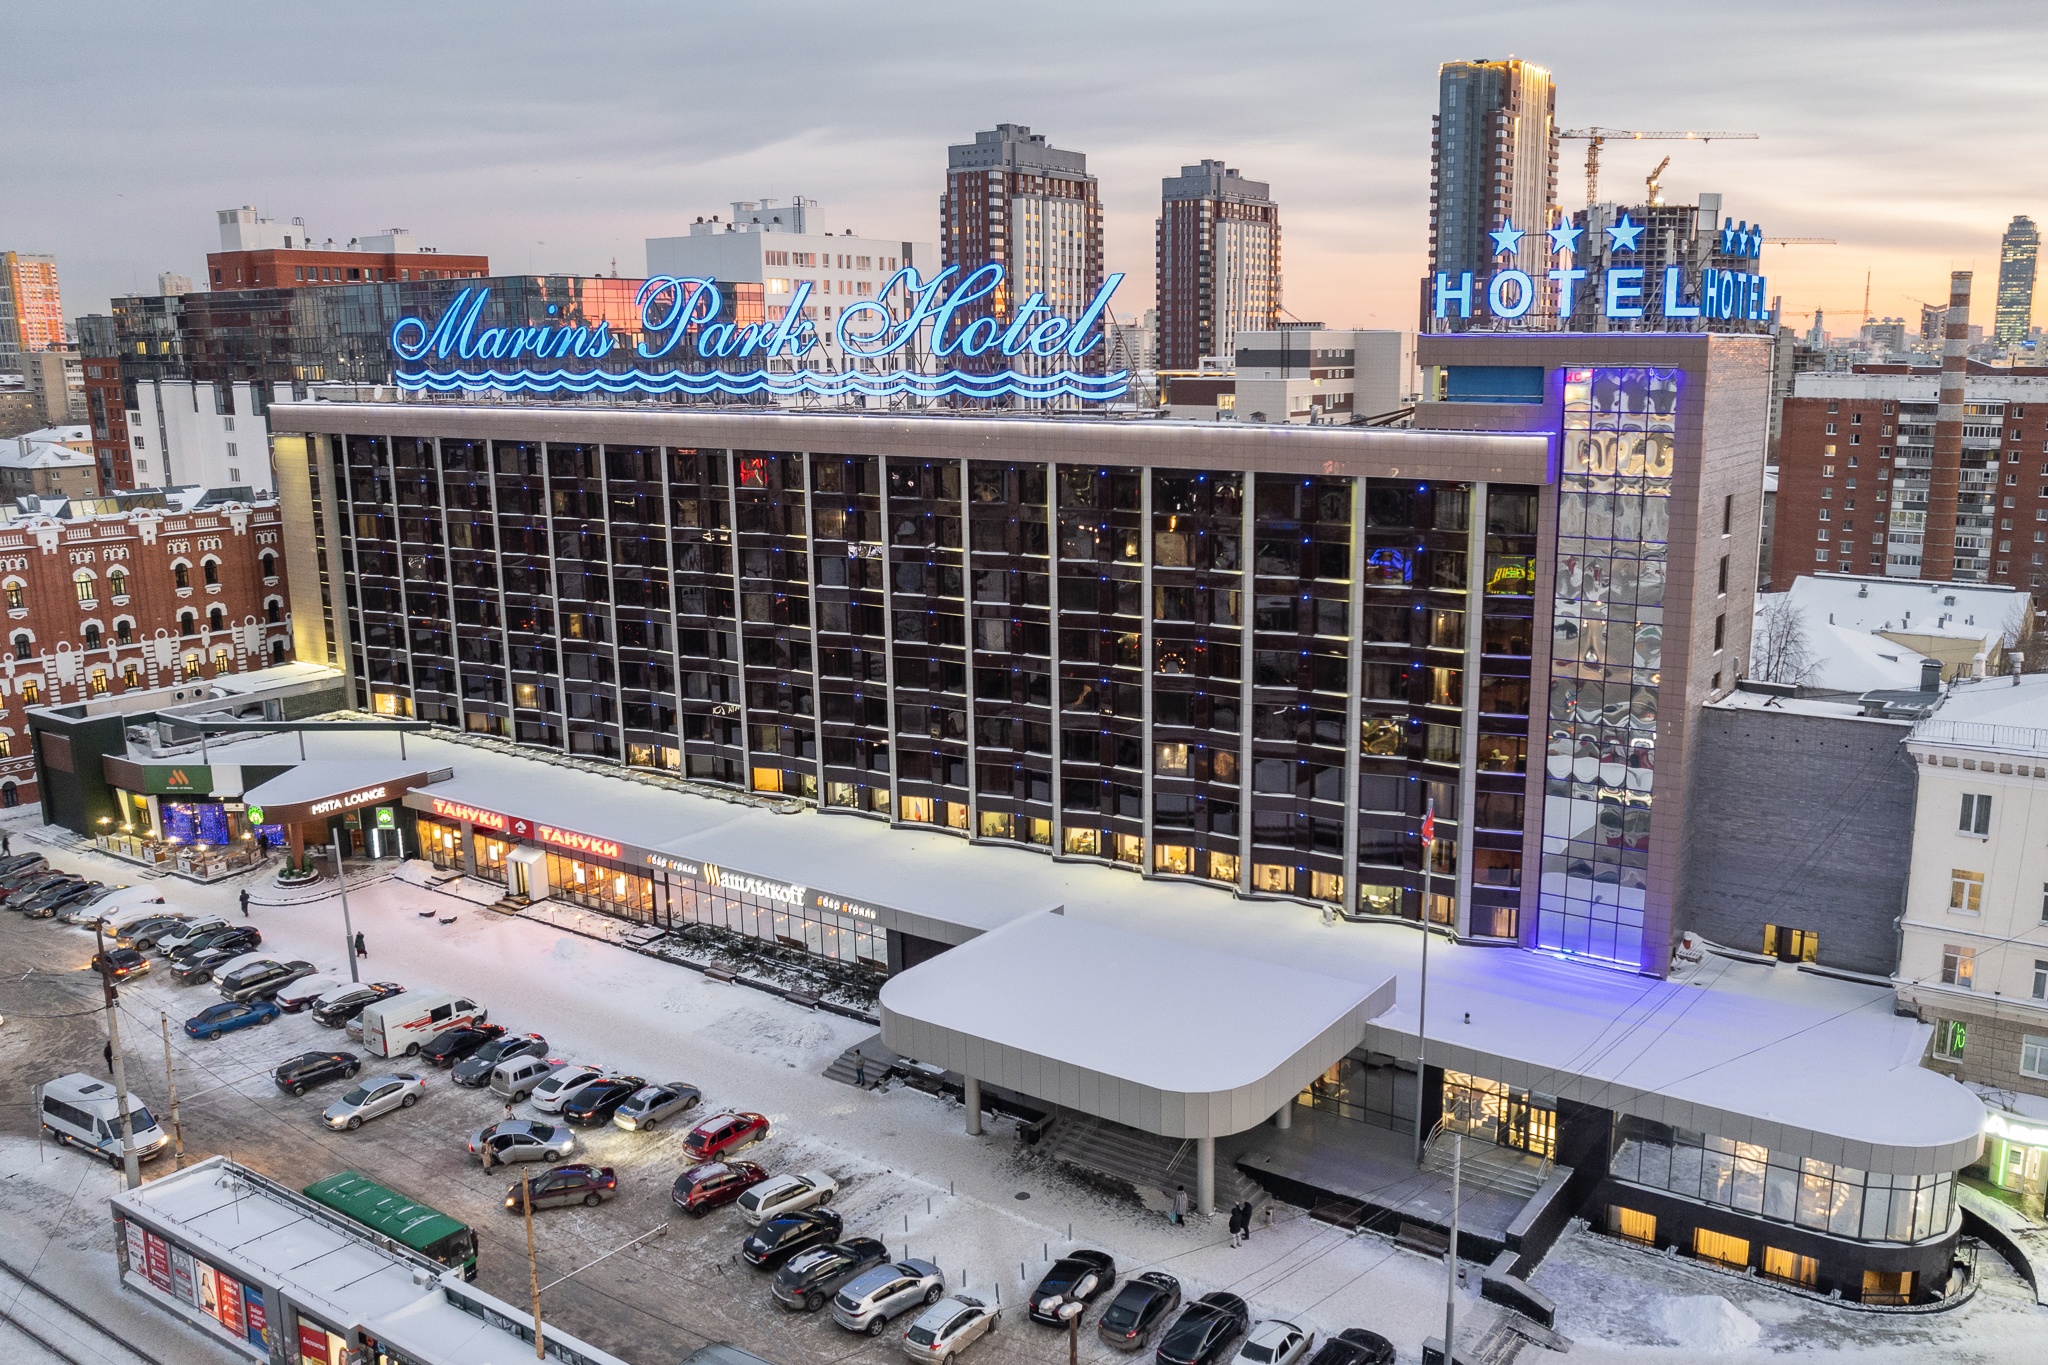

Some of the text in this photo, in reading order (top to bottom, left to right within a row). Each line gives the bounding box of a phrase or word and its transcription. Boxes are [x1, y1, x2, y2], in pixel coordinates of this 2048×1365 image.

[392, 263, 1126, 360] Marins Park Hotel
[1434, 265, 1700, 319] HOTEL
[1702, 267, 1771, 321] HOTEL
[311, 786, 387, 816] МЯТА LOUNGE
[432, 799, 507, 829] ТАНУКИ
[538, 825, 621, 858] ТАНУКИ
